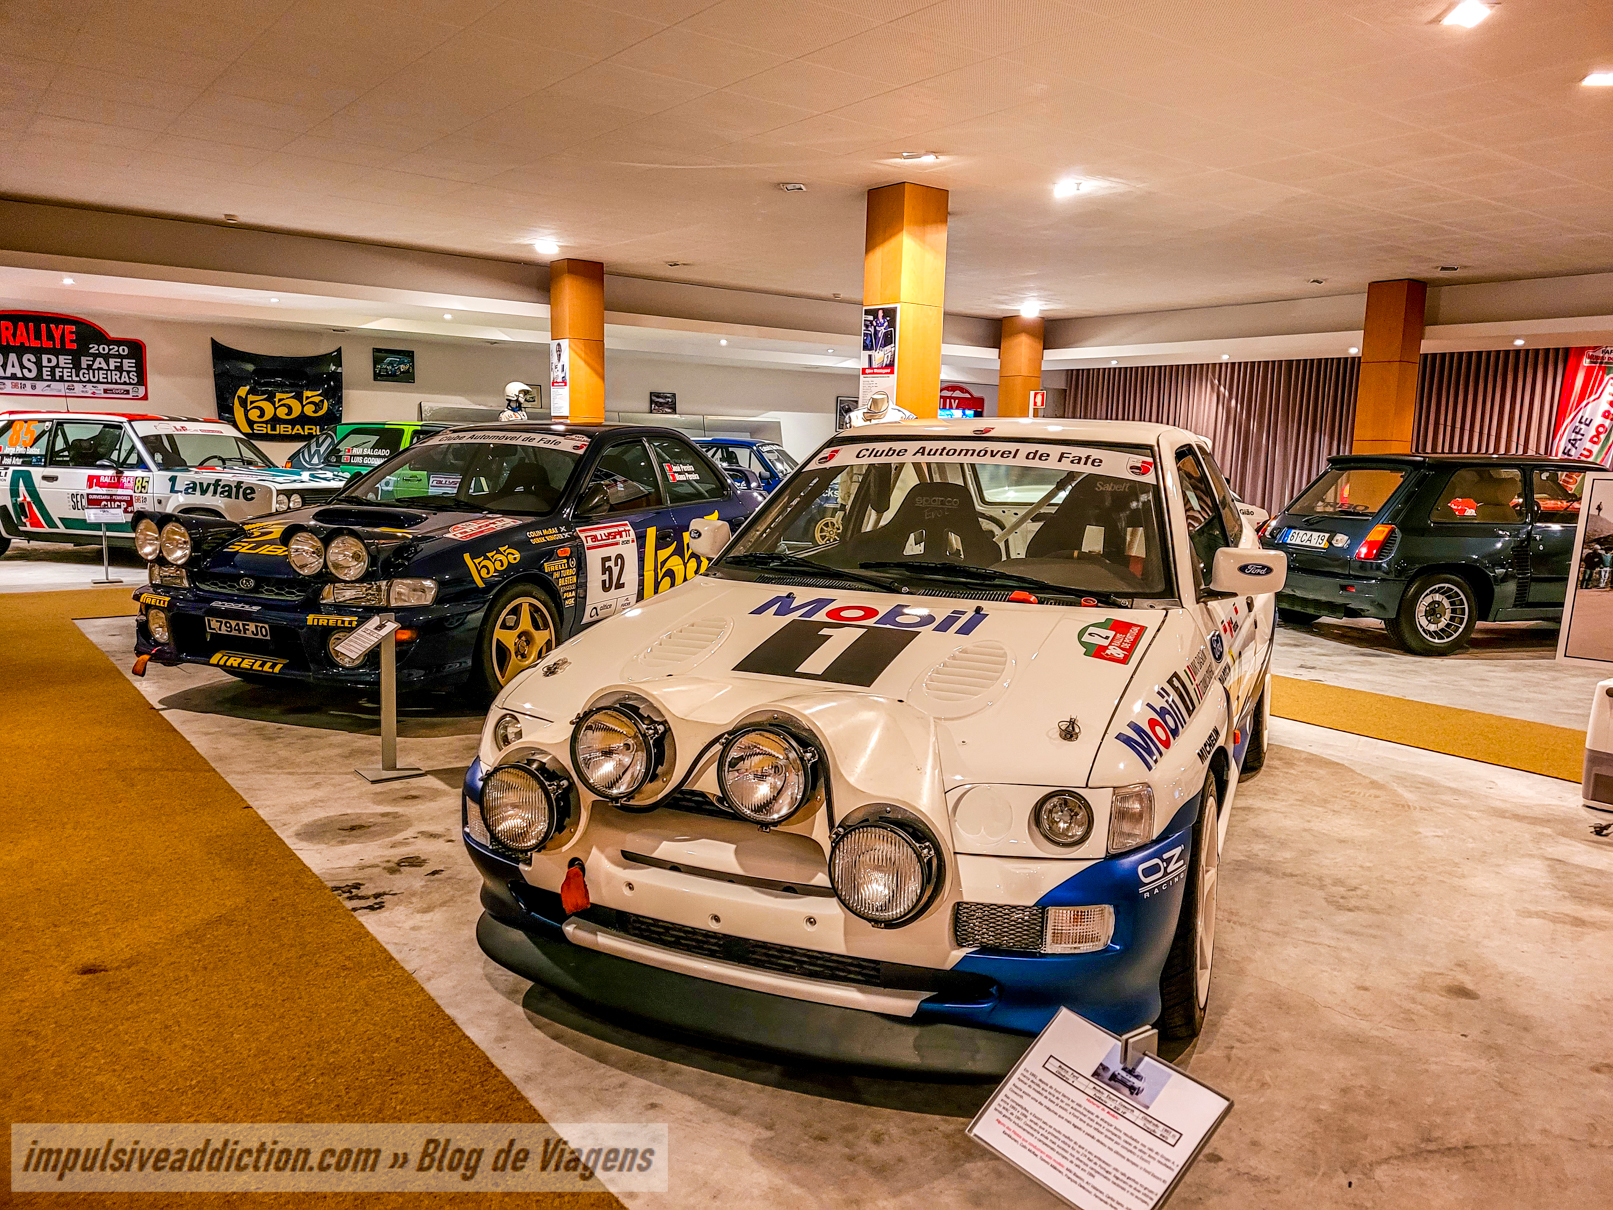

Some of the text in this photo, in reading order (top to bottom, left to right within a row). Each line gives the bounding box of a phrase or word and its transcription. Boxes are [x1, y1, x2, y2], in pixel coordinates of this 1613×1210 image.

[1, 321, 77, 350] RALLYE
[88, 344, 129, 355] 2020
[41, 354, 137, 371] DE FAFE
[42, 367, 138, 384] E FELGUEIRAS
[234, 388, 328, 424] 555
[8, 421, 38, 447] 85
[466, 434, 521, 442] Automóvel
[537, 437, 562, 446] Fafe
[1562, 415, 1594, 457] FAFE
[350, 456, 363, 464] LUIS
[363, 448, 390, 456] SALGADO
[855, 446, 1104, 468] Clube Automóvel de Fafe
[100, 475, 119, 483] RALLY
[134, 477, 151, 494] 85
[915, 496, 960, 506] sparco
[544, 559, 568, 572] PIRELLI
[600, 553, 625, 593] 52
[1244, 564, 1268, 576] Ford
[140, 593, 170, 607] PIRELLI
[307, 614, 358, 628] PIRELLI
[748, 595, 989, 636] Mobil
[1088, 632, 1111, 641] 2
[794, 626, 869, 676] 1
[209, 650, 289, 674] PIRELLI
[1114, 687, 1188, 773] Mobil
[1197, 726, 1221, 765] MICHELIN
[1137, 844, 1186, 884] OZ
[1144, 873, 1185, 899] RACING
